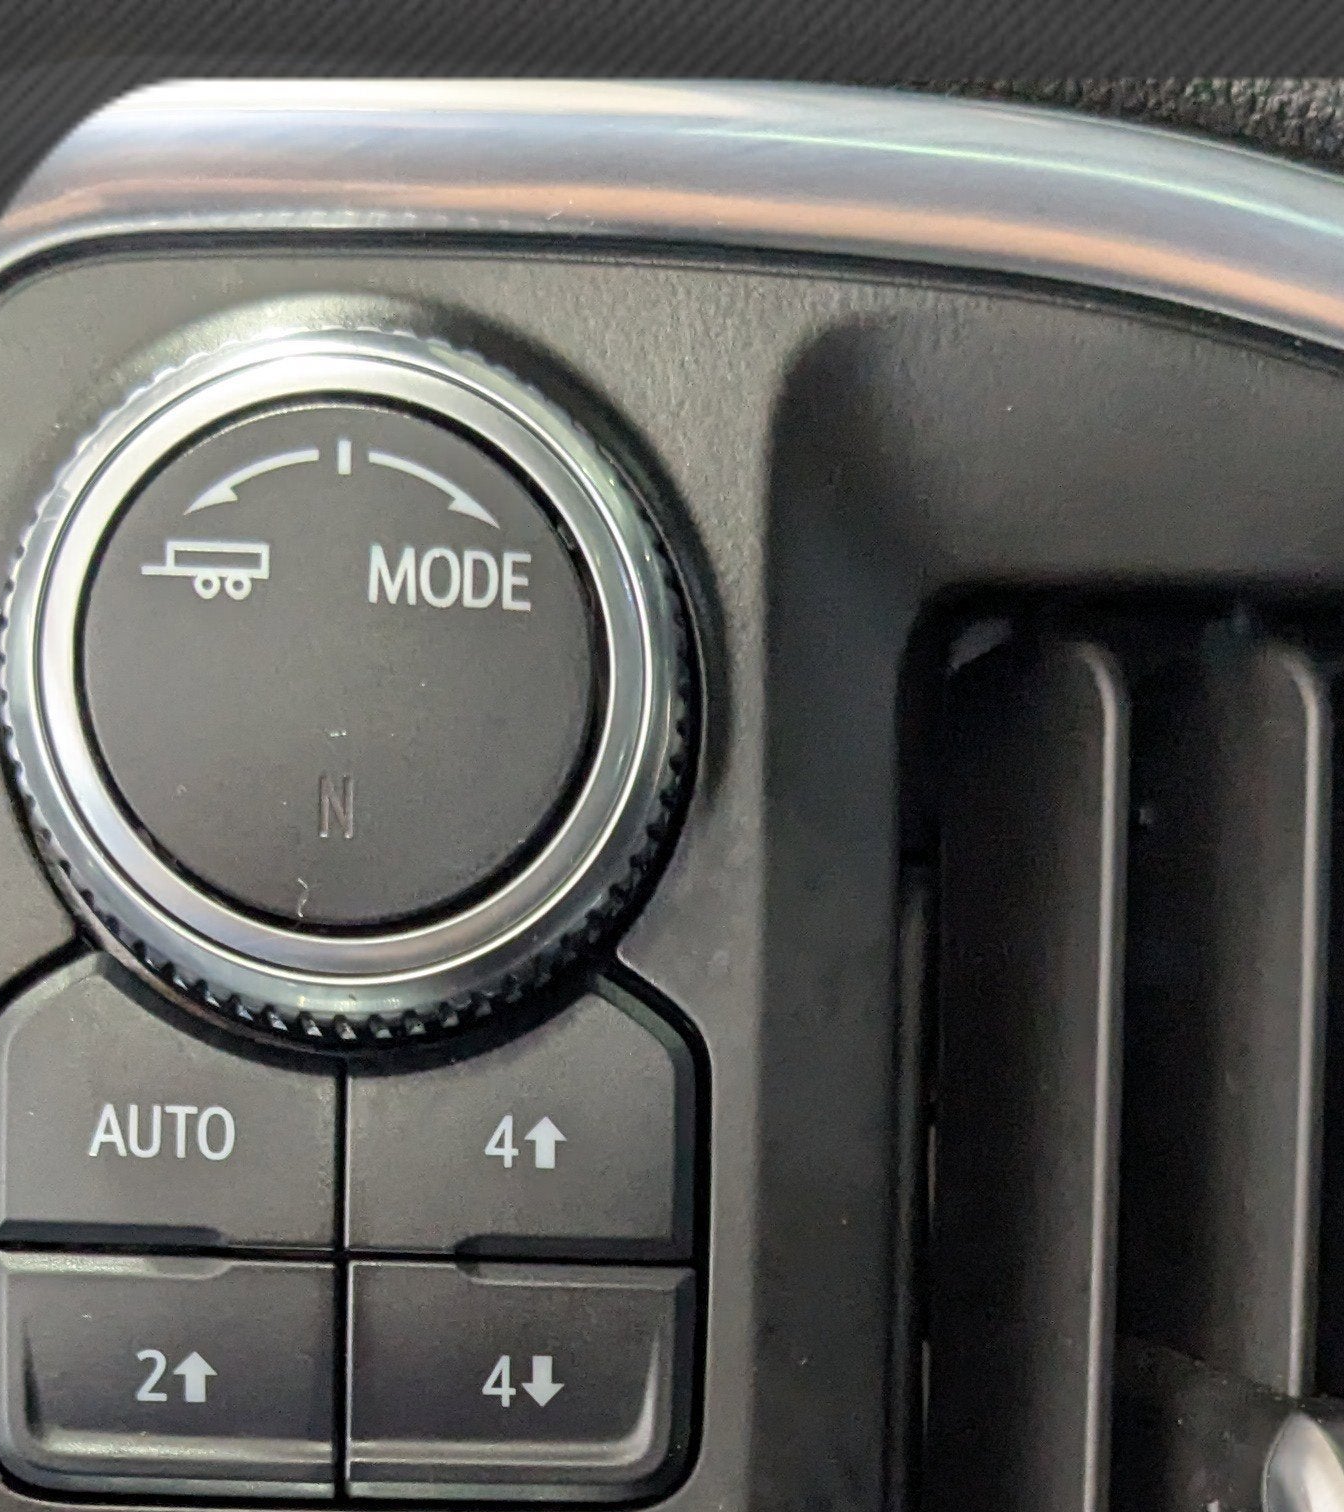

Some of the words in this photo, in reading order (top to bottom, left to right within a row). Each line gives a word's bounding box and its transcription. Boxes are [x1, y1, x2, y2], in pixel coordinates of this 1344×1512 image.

[367, 542, 532, 612] MODE
[317, 774, 355, 840] N
[89, 1103, 236, 1162] AUTO
[483, 1114, 519, 1169] 4
[135, 1349, 168, 1402] 2
[481, 1354, 516, 1408] 4
